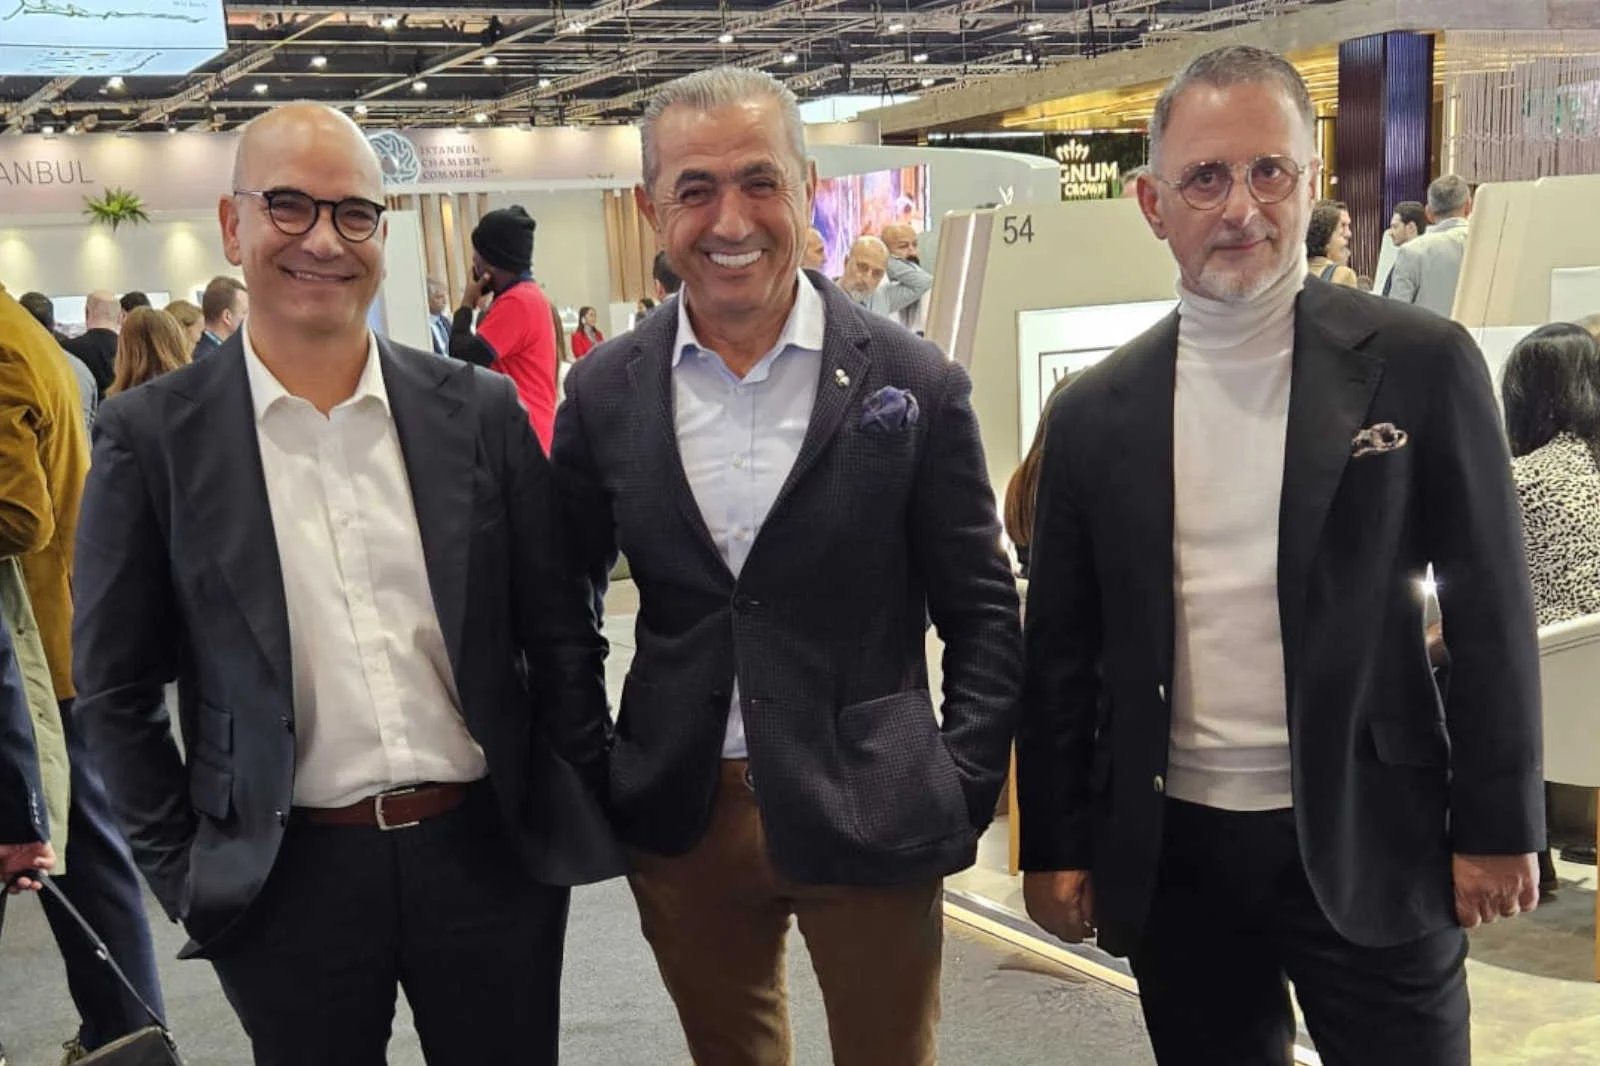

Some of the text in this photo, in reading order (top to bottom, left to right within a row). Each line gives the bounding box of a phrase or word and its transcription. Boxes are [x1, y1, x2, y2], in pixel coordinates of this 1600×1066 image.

[421, 157, 481, 168] CHAMBER
[422, 169, 486, 179] COMMERCE
[1065, 182, 1107, 196] CROWN
[1004, 214, 1035, 244] 54
